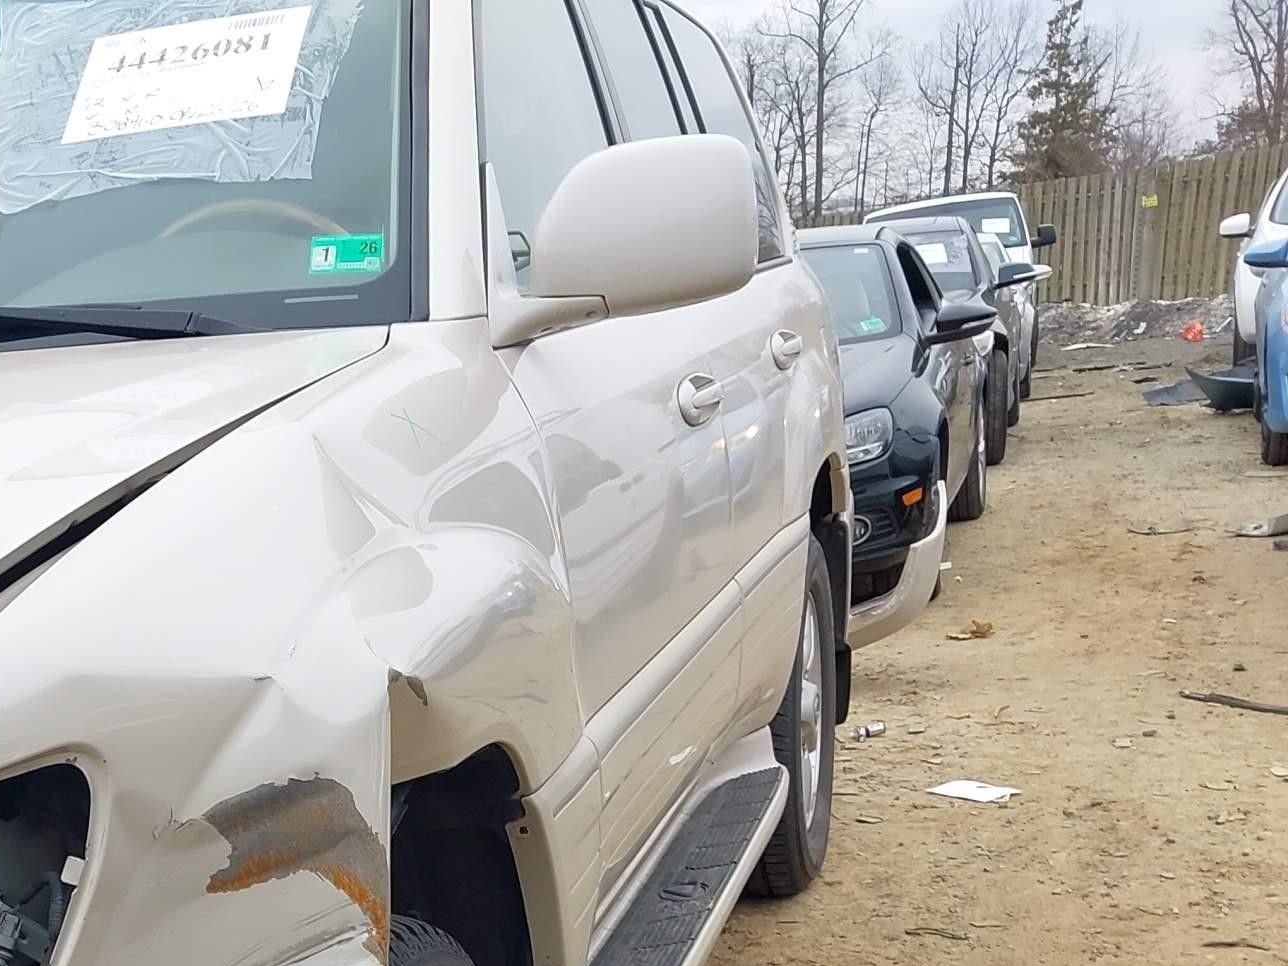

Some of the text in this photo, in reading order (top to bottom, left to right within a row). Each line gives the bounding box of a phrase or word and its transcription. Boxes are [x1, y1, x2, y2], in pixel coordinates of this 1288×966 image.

[107, 32, 271, 73] 44426081
[321, 246, 330, 262] 1
[359, 241, 378, 255] 26
